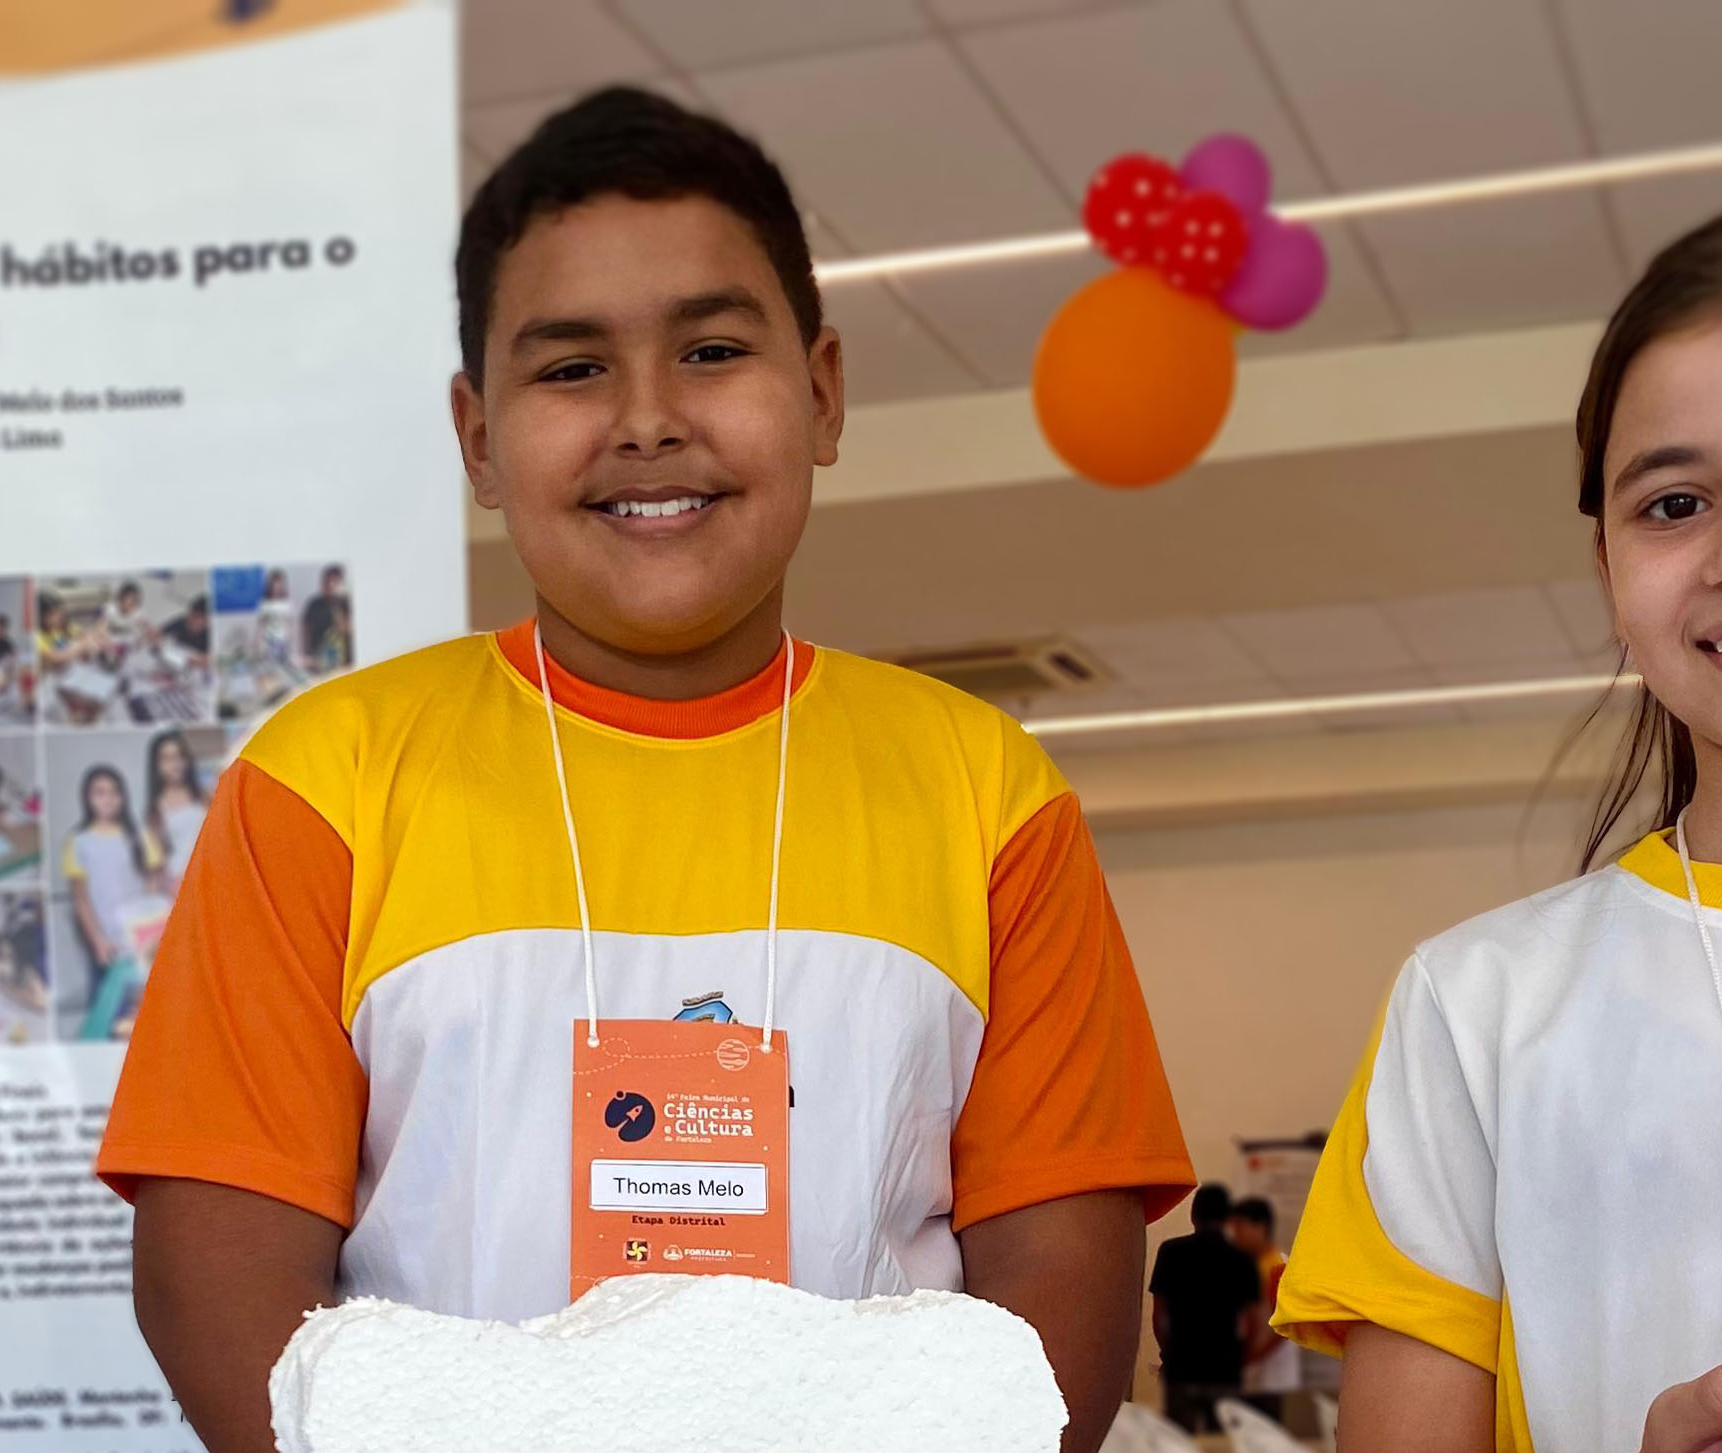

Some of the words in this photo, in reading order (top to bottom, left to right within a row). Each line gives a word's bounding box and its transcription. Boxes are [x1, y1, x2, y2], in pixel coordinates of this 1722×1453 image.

[0, 240, 180, 289] hábitos
[193, 239, 312, 288] para
[324, 235, 356, 267] o
[663, 1103, 754, 1121] Ciências
[675, 1119, 754, 1137] Cultura
[613, 1177, 692, 1196] Thomas
[698, 1180, 744, 1198] Melo
[632, 1215, 664, 1226] Etapa
[669, 1216, 726, 1226] Distrital
[683, 1248, 733, 1258] FORTALEZA
